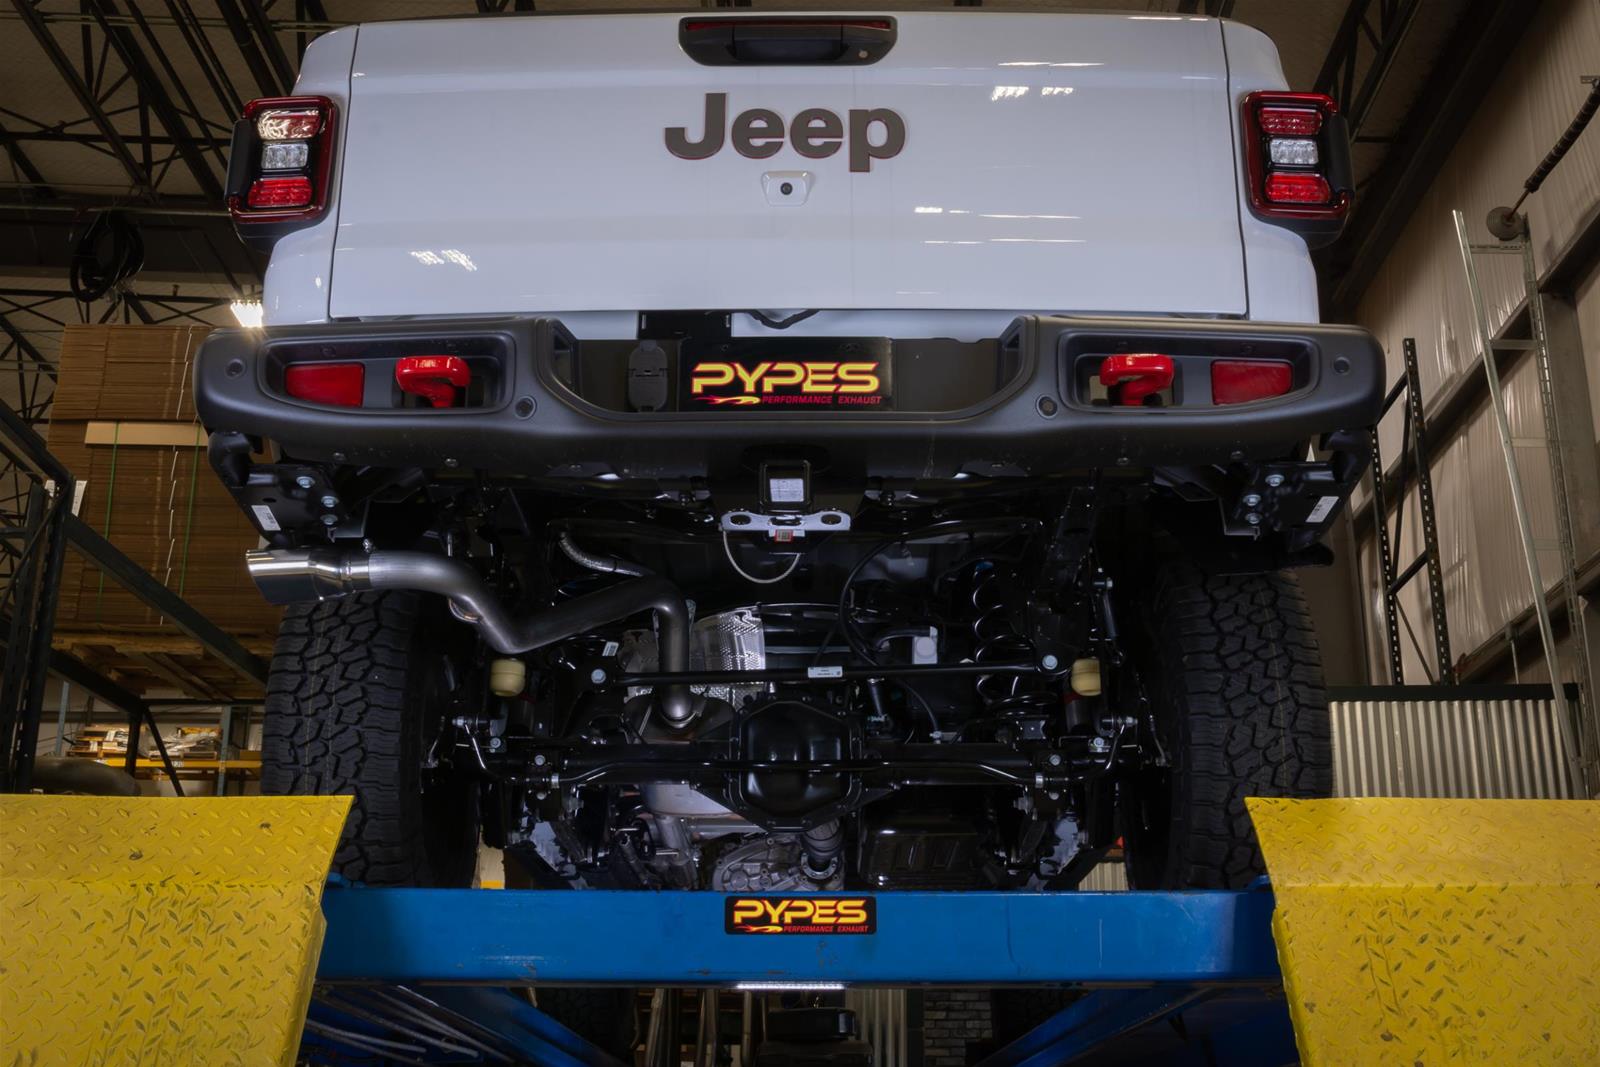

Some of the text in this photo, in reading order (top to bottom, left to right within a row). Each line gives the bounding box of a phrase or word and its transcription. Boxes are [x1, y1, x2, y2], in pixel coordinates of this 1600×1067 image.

[664, 92, 906, 173] Jeep
[691, 362, 880, 393] PYPES
[762, 395, 882, 404] PERFORMANCE EXHAUST
[733, 899, 867, 924] PYPES
[783, 925, 869, 933] PERFORMANCE EXHAUST
